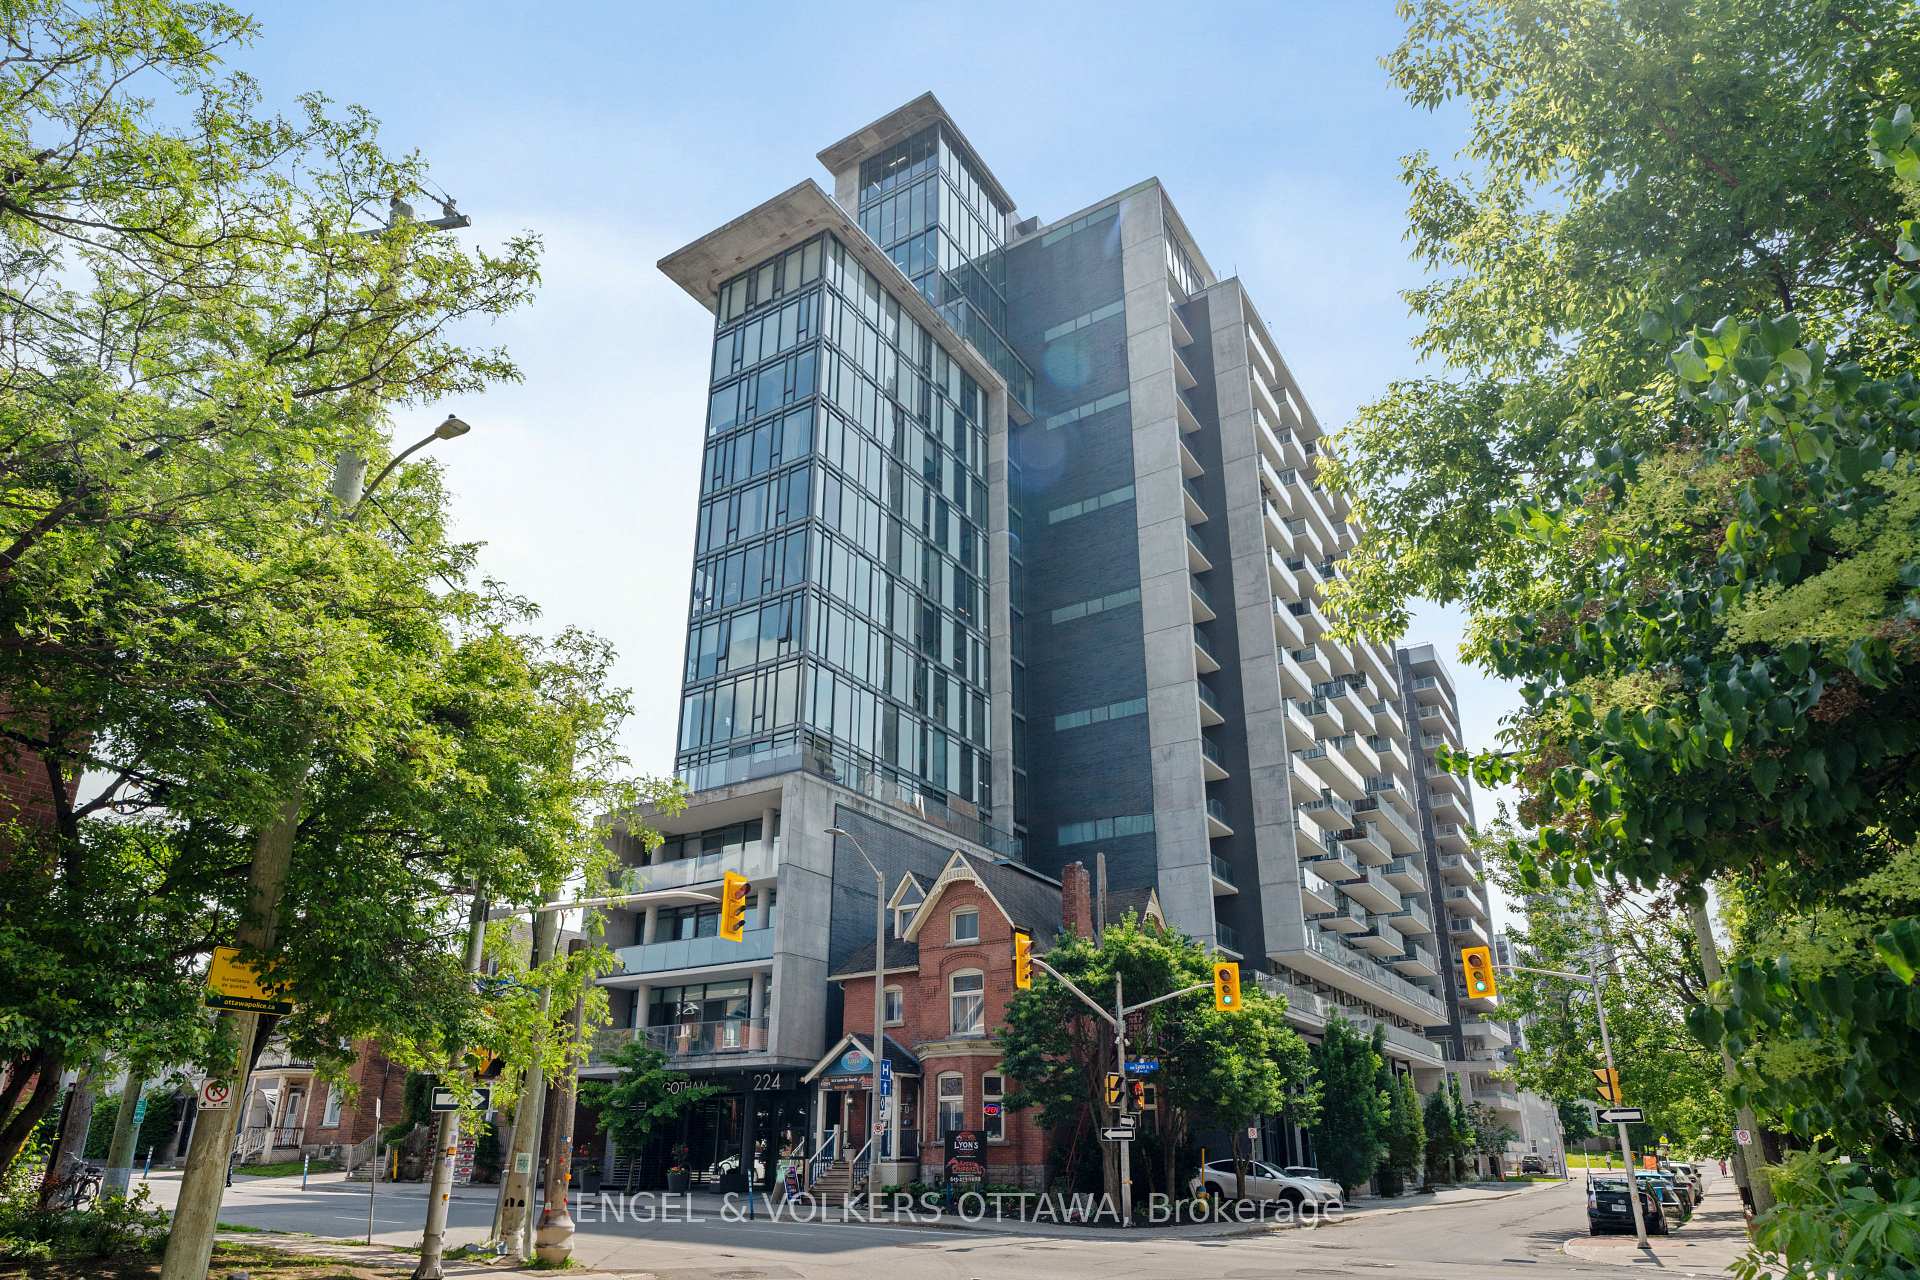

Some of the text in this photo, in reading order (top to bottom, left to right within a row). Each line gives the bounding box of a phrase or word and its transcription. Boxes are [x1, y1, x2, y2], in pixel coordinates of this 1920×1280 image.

[223, 999, 275, 1010] ottawapolice.ca
[882, 1064, 889, 1076] H
[753, 1073, 781, 1091] 224
